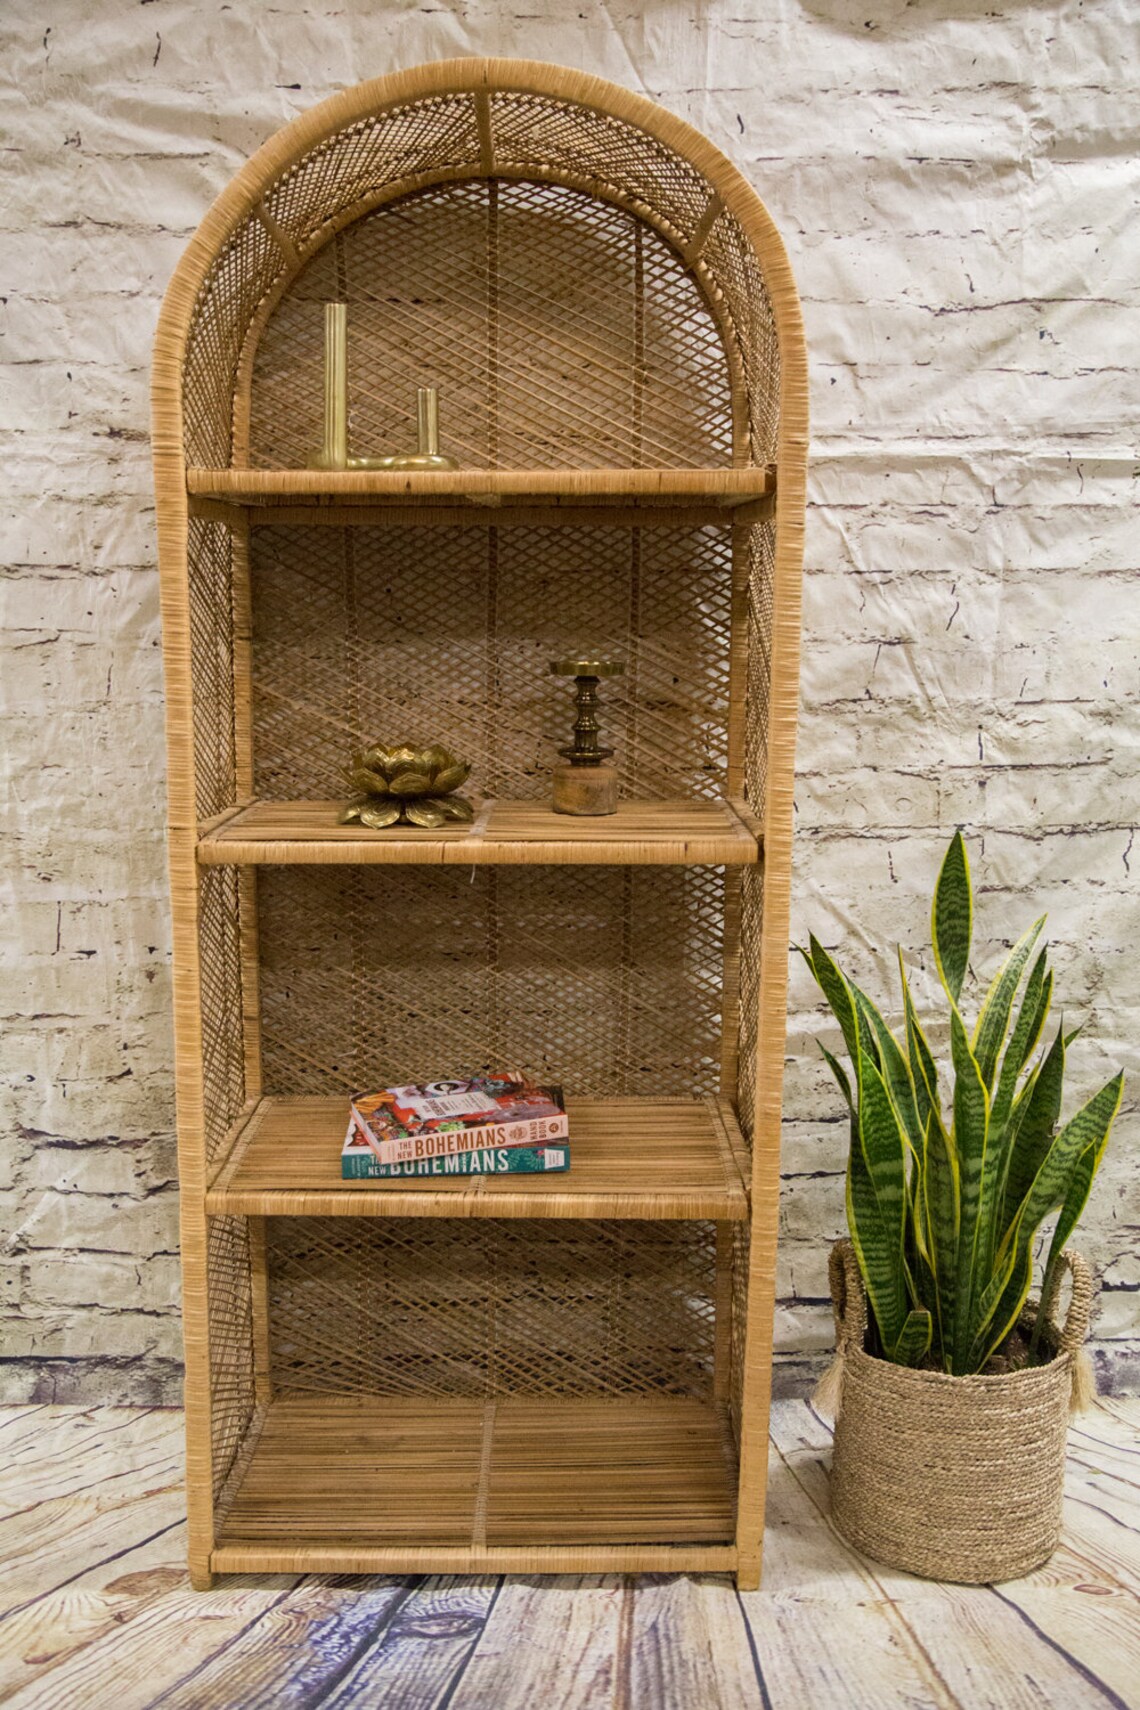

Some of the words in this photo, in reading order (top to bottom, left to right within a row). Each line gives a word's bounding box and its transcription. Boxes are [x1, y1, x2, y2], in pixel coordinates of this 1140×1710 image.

[539, 1120, 547, 1138] BOOK
[399, 1140, 412, 1150] THE
[414, 1127, 506, 1157] BOHEMIANS
[397, 1151, 413, 1160] NEW
[368, 1166, 387, 1176] NEW
